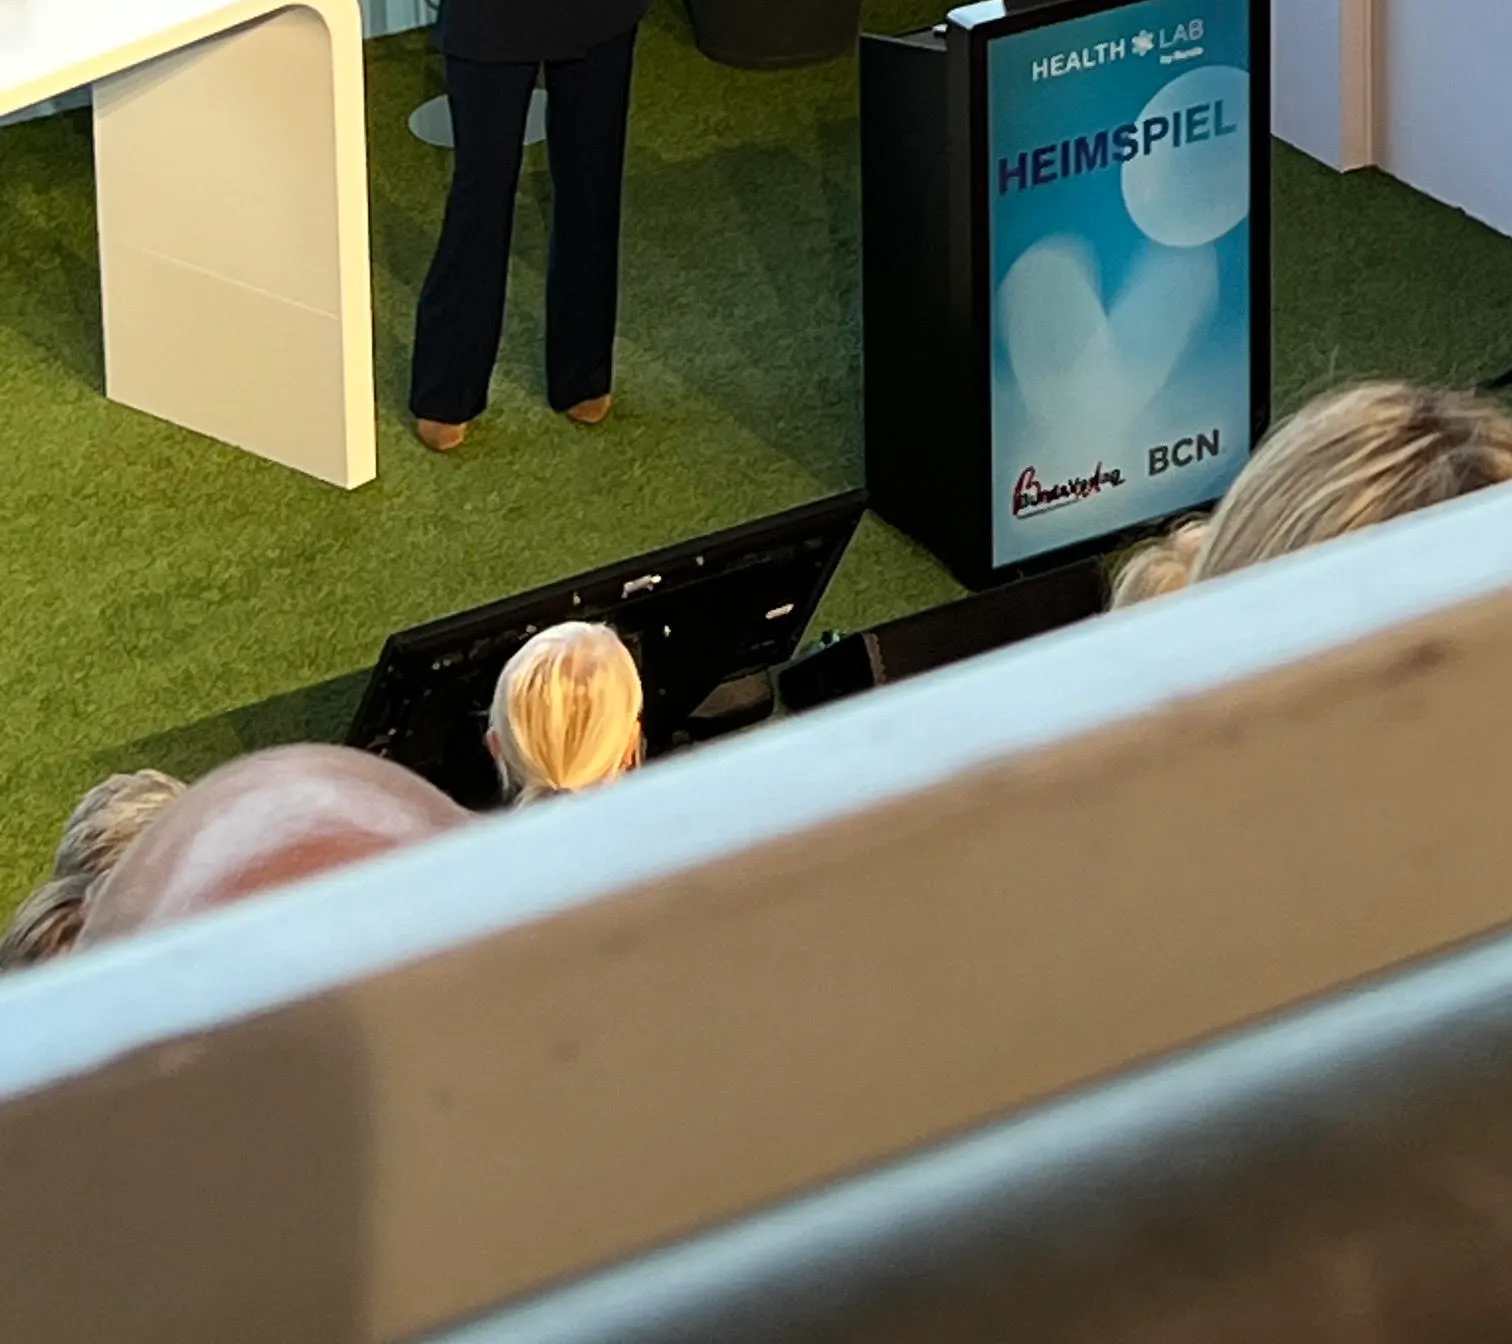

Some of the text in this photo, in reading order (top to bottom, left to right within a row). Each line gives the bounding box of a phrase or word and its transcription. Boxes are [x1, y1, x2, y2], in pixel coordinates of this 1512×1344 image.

[1032, 37, 1127, 83] HEALTH
[1159, 17, 1204, 50] LAB
[998, 98, 1238, 196] HEIMSPIEL
[1148, 428, 1220, 477] BCN
